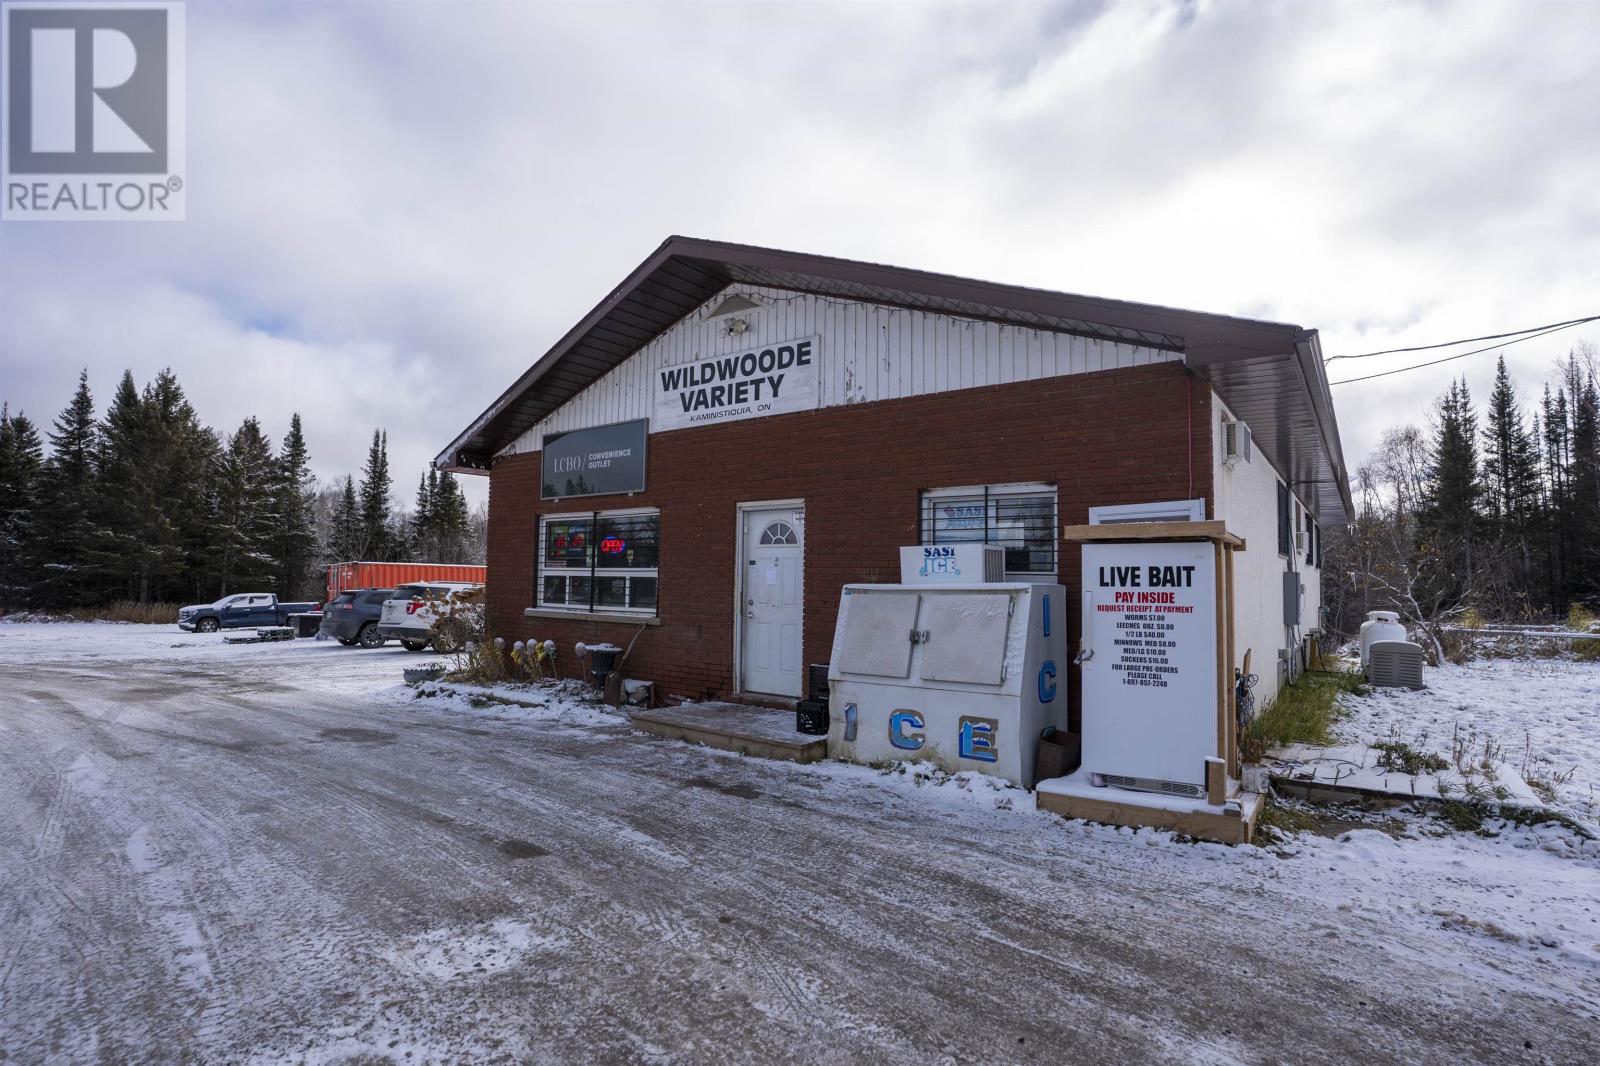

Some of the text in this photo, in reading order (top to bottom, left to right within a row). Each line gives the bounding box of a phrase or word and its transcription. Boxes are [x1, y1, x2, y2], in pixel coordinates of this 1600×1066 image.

[661, 341, 812, 392] WILDWOODE
[680, 373, 785, 413] VARIETY
[690, 403, 771, 422] KAMINISTIQUIA, ON
[588, 448, 632, 461] CONVENIENCE
[554, 455, 581, 472] LCBO
[588, 459, 612, 469] OUTLET
[601, 539, 625, 553] OPEN
[1099, 565, 1195, 587] LIVE BAIT
[1115, 591, 1175, 604] PAY INSIDE
[1126, 605, 1152, 613] RECEIPT
[1155, 605, 1162, 613] AT
[1163, 605, 1194, 614] PAYMENT
[1114, 639, 1142, 647] MINNOWS
[1158, 640, 1176, 648] $8.00
[1120, 655, 1147, 664] SUCKERS
[1111, 663, 1179, 674] FOR LARGE PRE-ORDERS
[1127, 672, 1162, 680] PLEASE CALL
